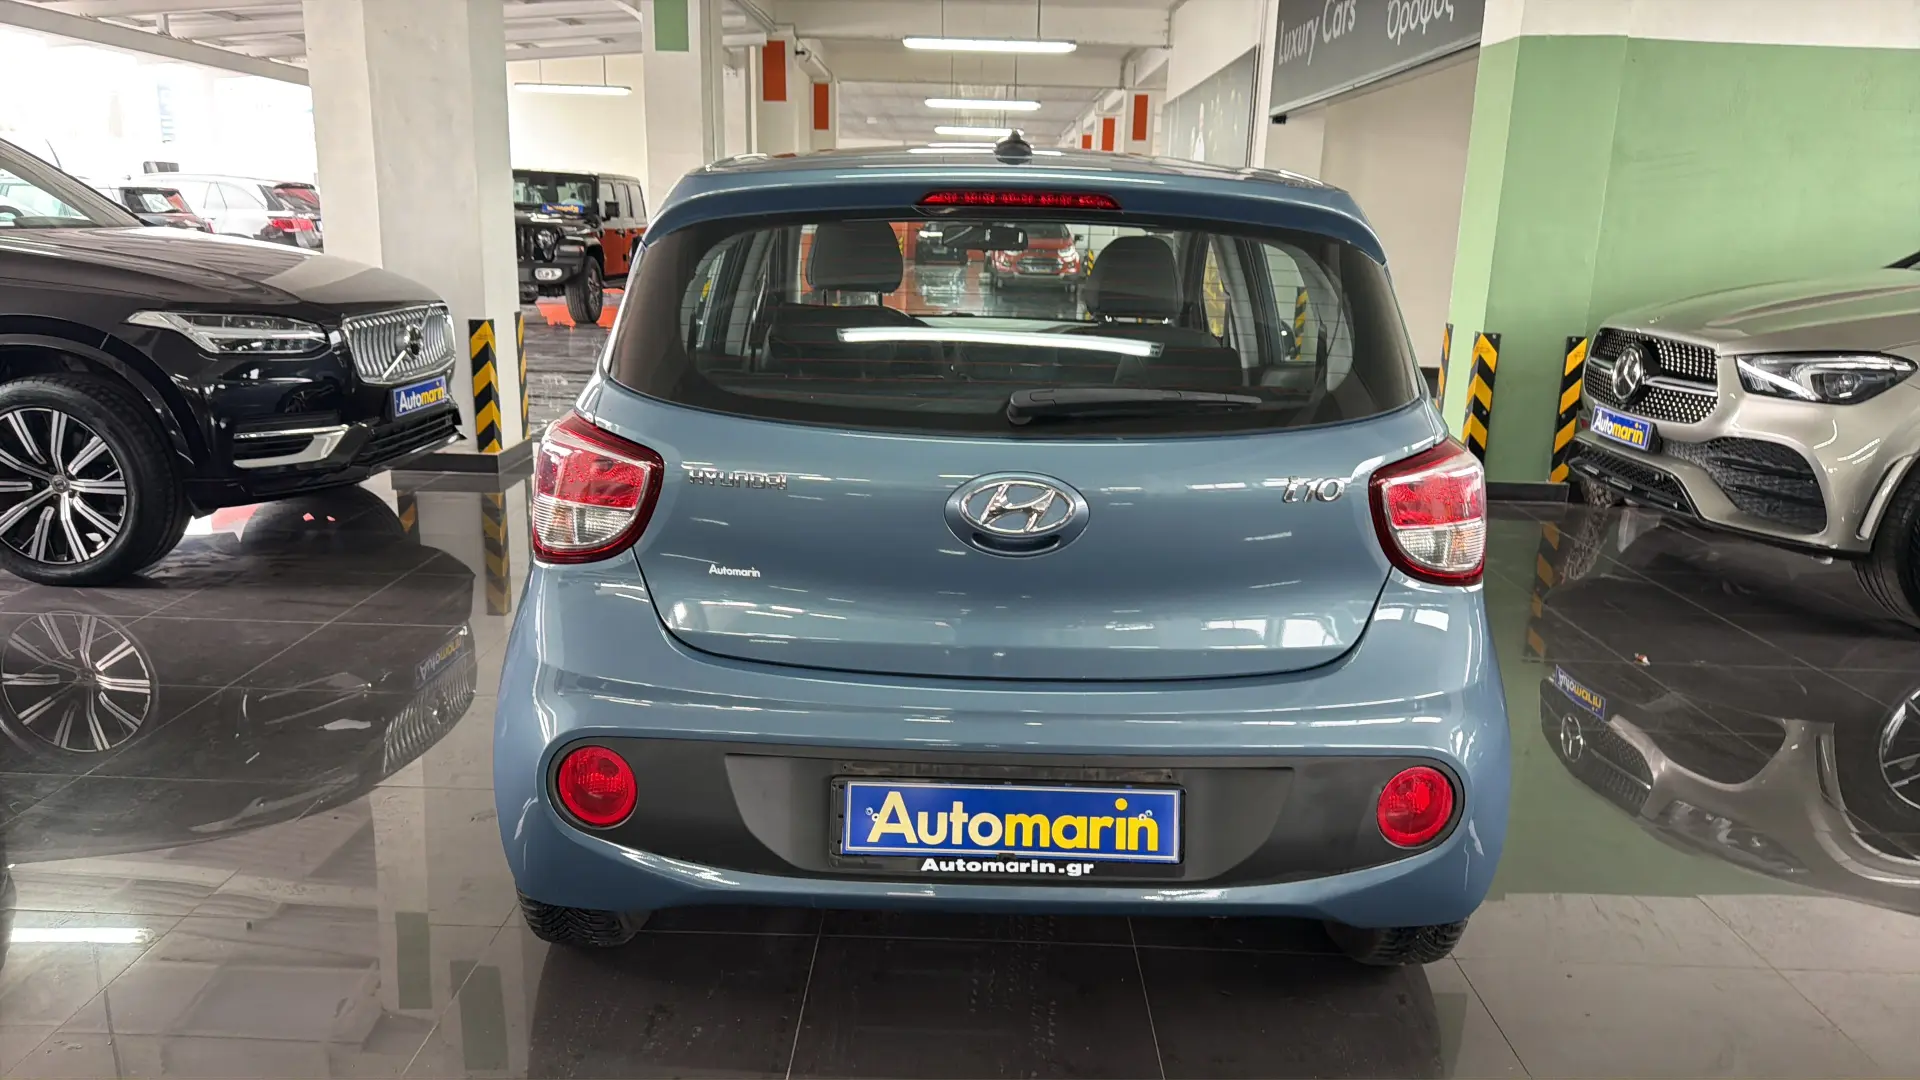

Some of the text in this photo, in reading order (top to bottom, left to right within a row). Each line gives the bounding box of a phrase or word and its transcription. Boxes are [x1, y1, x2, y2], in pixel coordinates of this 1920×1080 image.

[1278, 0, 1356, 66] Luxury Cars
[399, 382, 445, 412] Automarin
[1593, 411, 1644, 445] Automarin
[688, 469, 788, 490] HYUNDAI
[1282, 476, 1345, 503] i10
[708, 564, 761, 578] Automarin
[866, 791, 1159, 852] Automarin
[921, 858, 1095, 876] Automarin.gr
